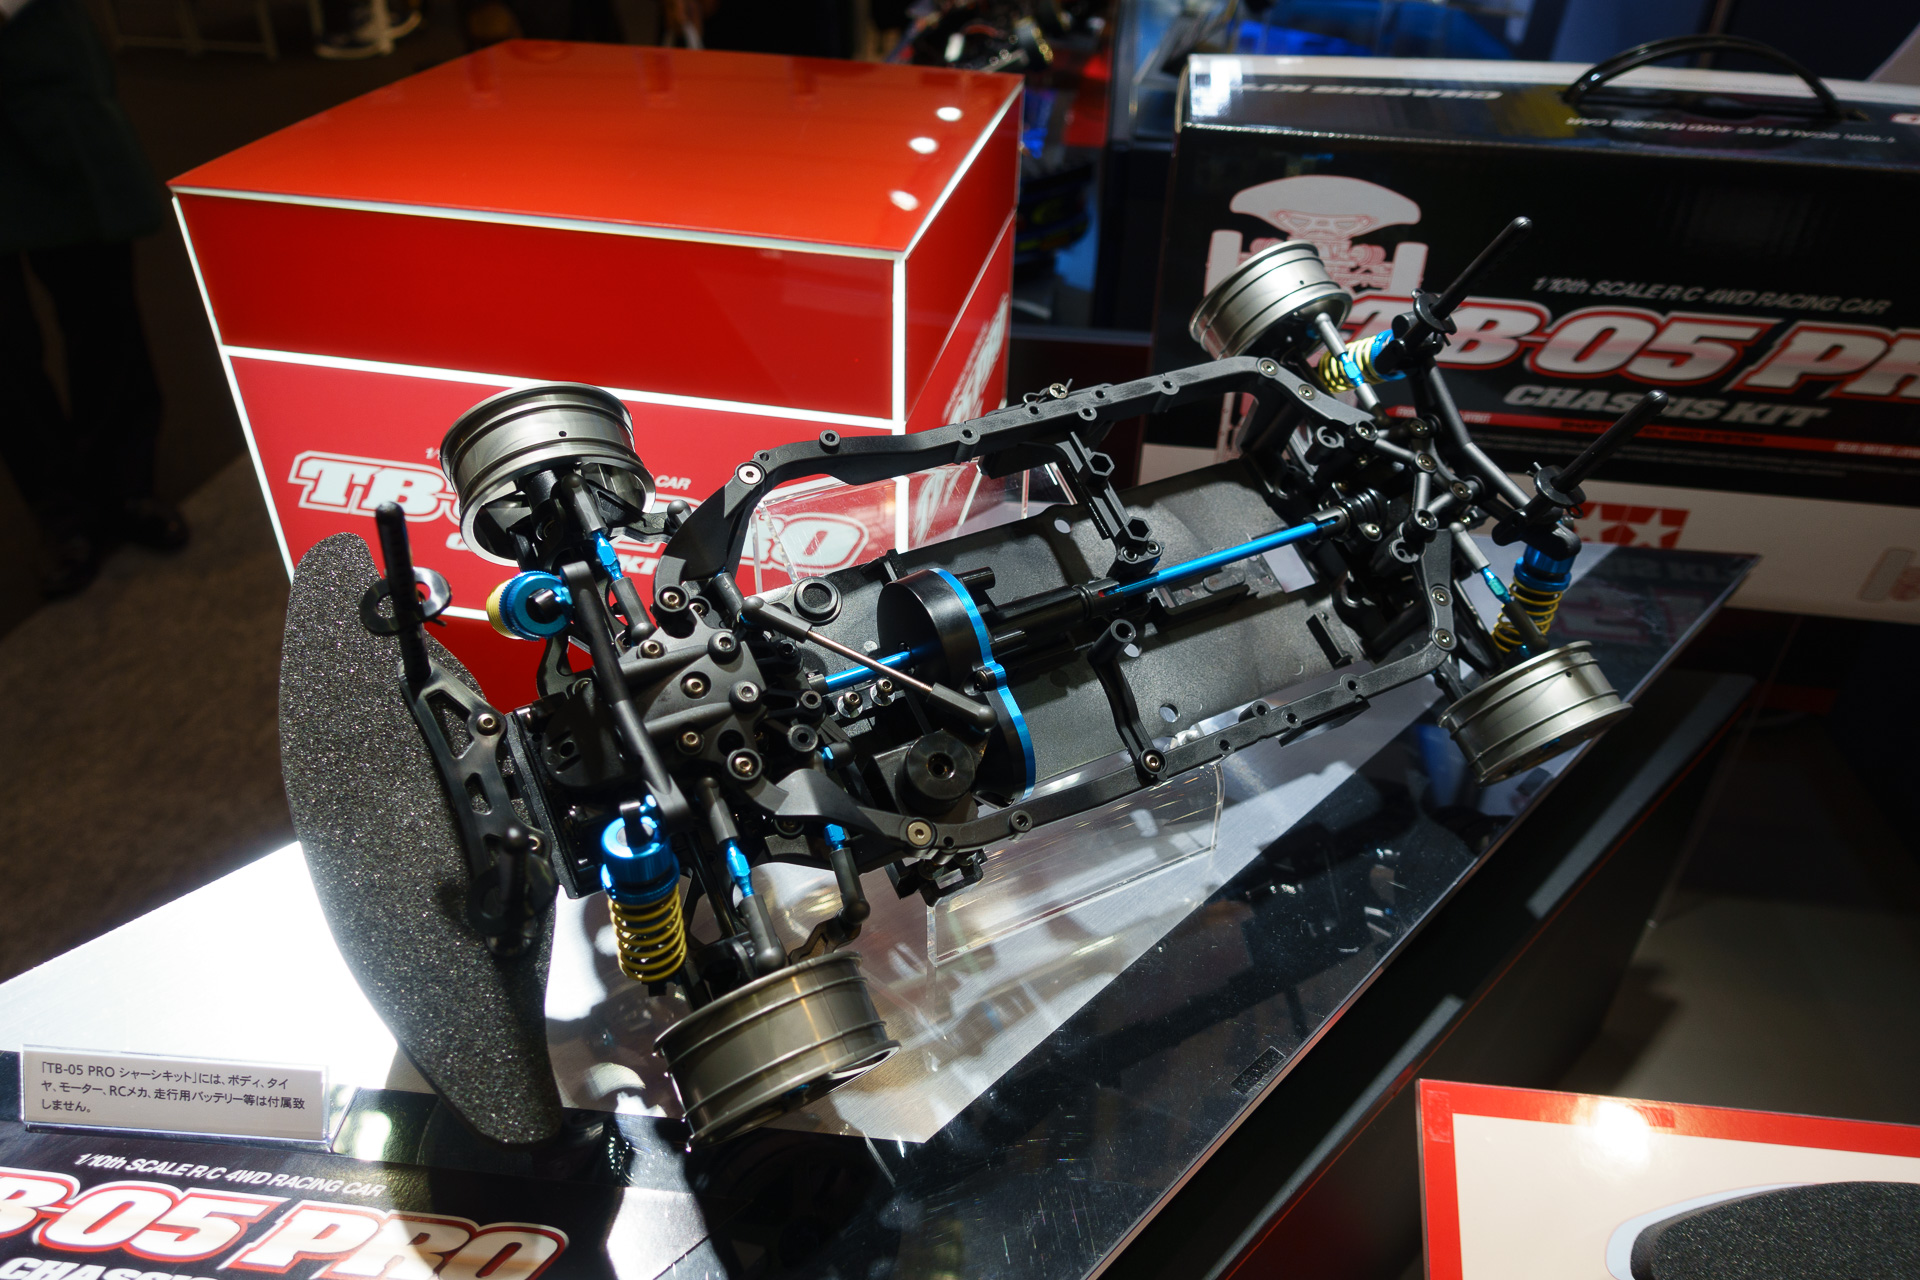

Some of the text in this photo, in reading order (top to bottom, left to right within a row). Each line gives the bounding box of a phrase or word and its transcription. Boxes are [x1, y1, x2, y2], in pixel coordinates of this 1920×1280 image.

[1589, 279, 1666, 299] SCALE
[1704, 286, 1758, 306] 4WD
[1755, 289, 1841, 311] RACING
[1839, 298, 1892, 316] CAR
[1503, 383, 1831, 427] CHASIS KIT
[288, 450, 461, 525] TB-
[654, 475, 691, 491] CAR
[88, 1065, 116, 1078] PRO
[41, 1099, 93, 1115] しません。
[74, 1152, 388, 1198] 1/10th SCALE R/C 4WD RACING CAR
[220, 1200, 568, 1280] PRO
